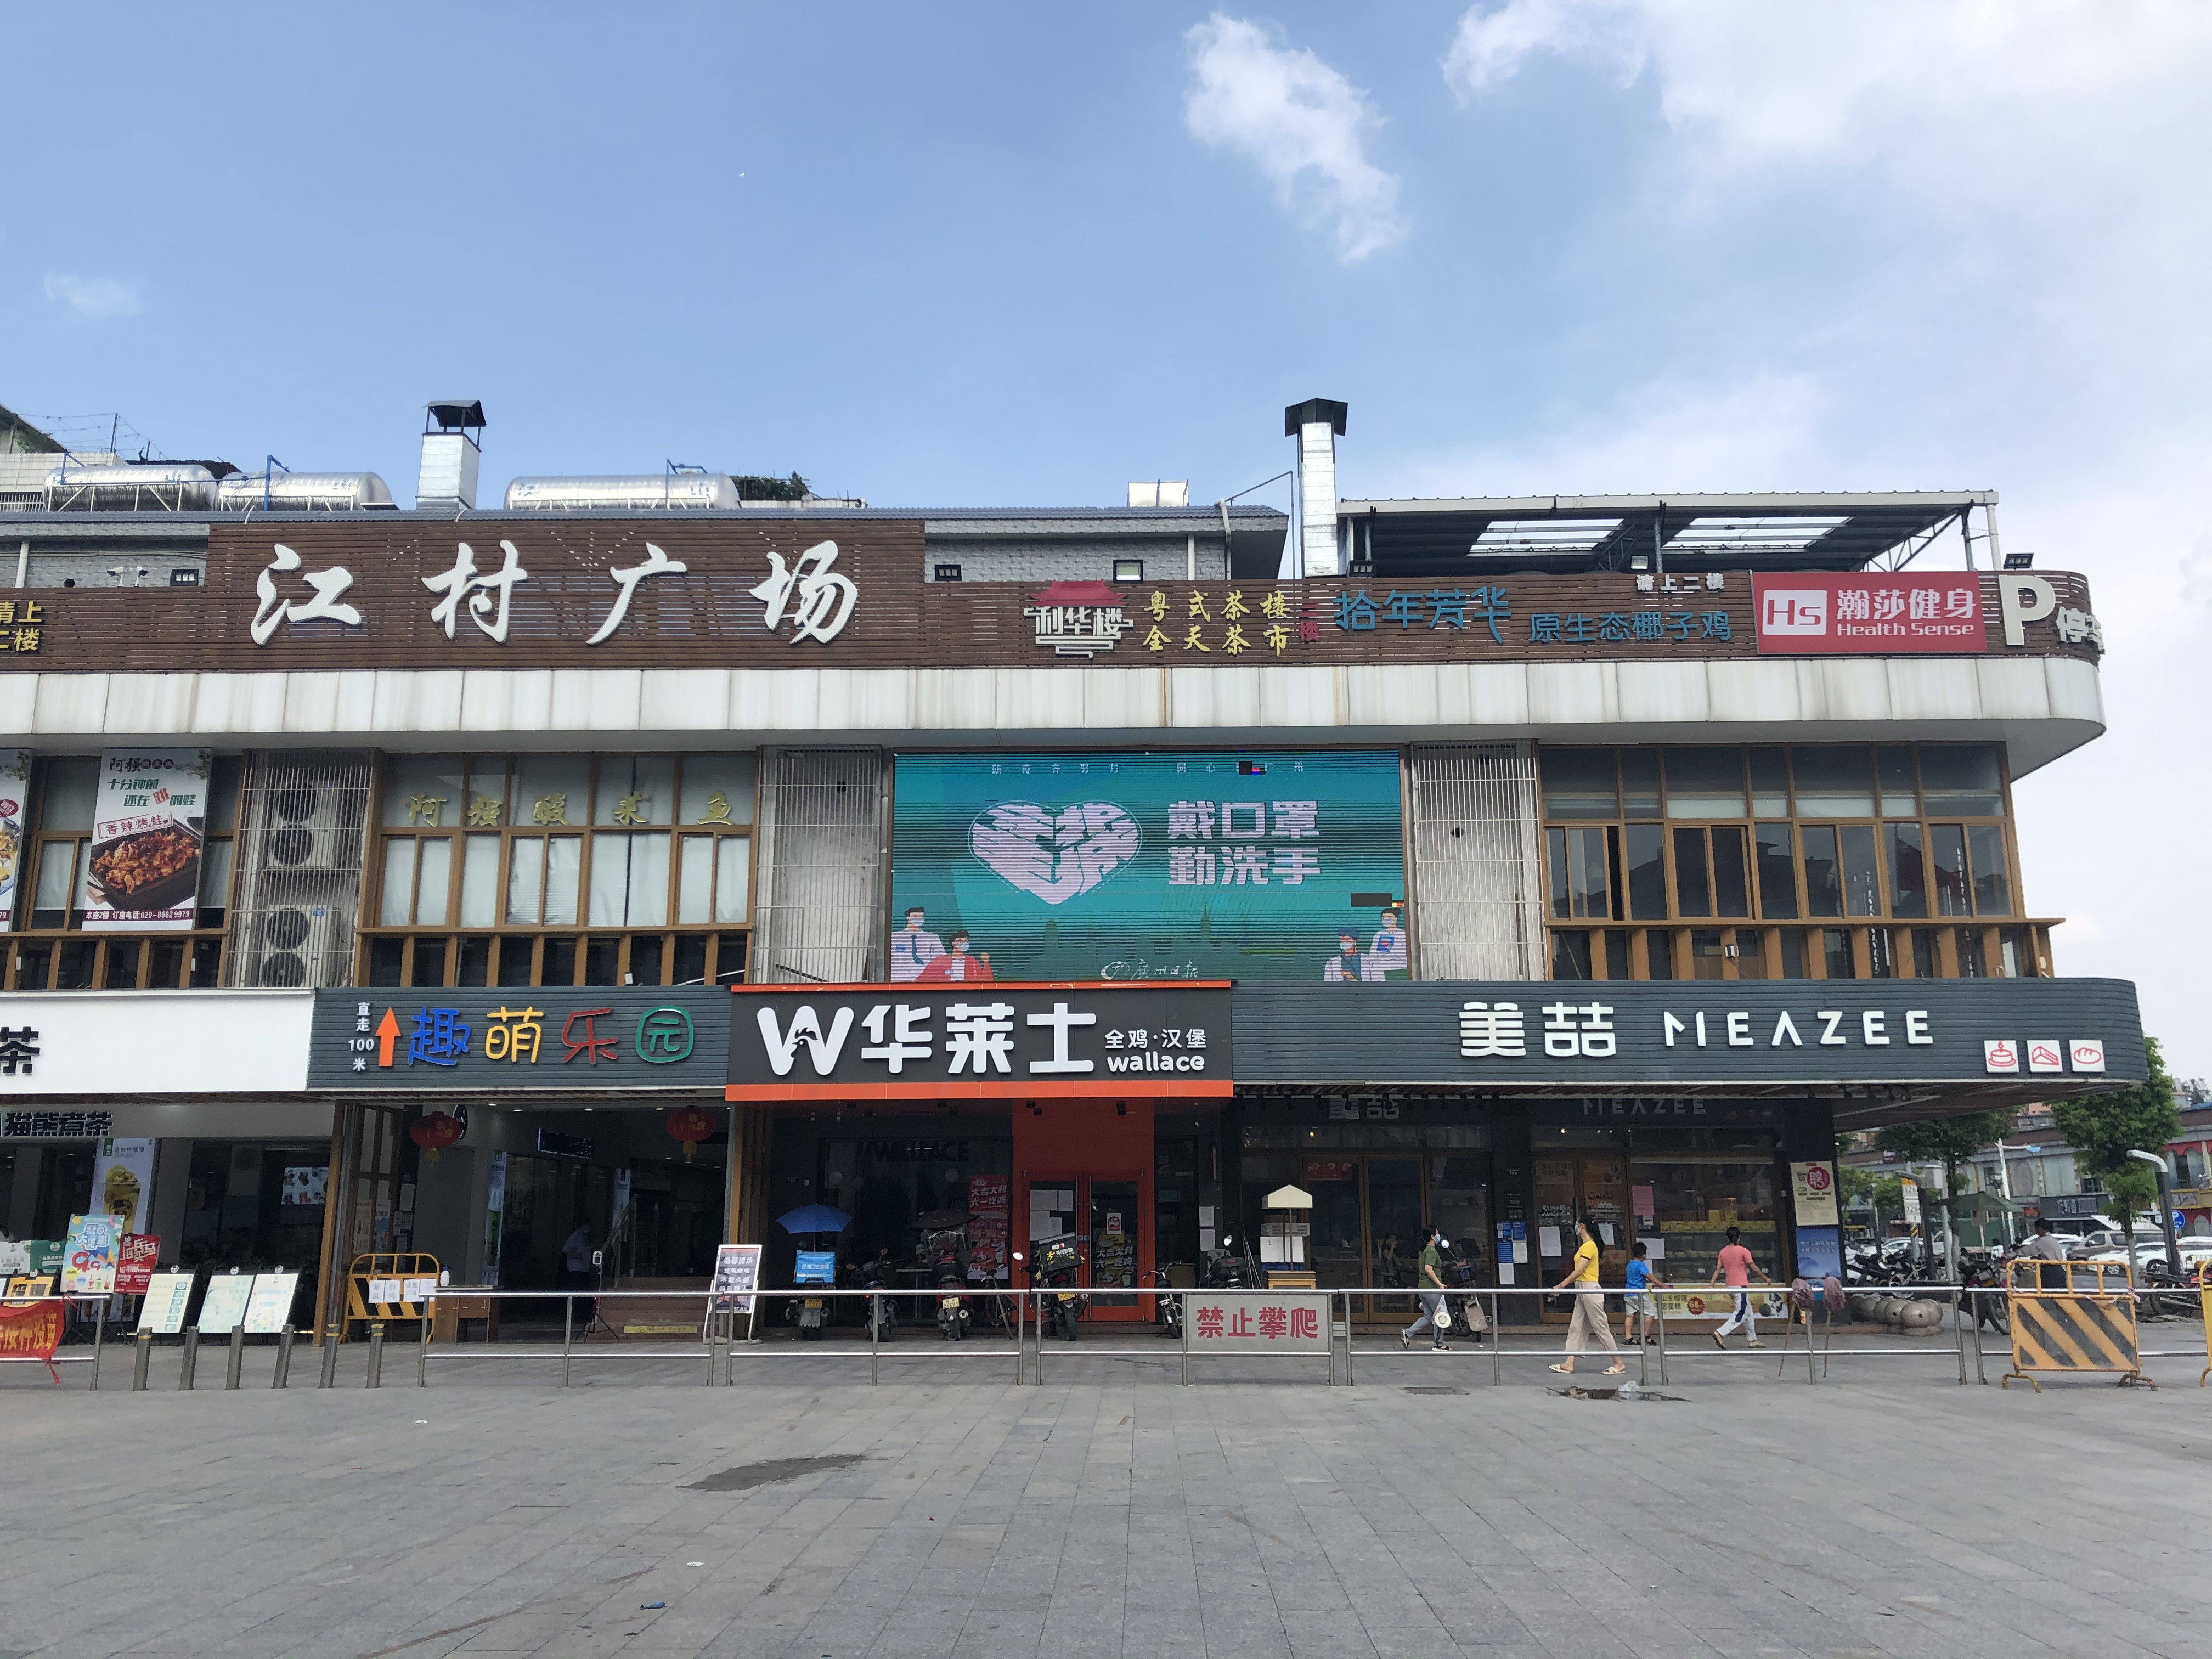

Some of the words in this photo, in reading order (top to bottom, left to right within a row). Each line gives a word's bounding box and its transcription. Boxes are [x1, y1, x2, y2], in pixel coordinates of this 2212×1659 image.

[250, 540, 859, 646] 江村广场
[1636, 573, 1724, 592] 请上二楼
[1144, 590, 1290, 622] 粤式茶楼
[1332, 586, 1512, 644] 拾年芳华
[1837, 588, 1978, 620] 瀚莎健身
[1998, 574, 2056, 646] P
[1024, 606, 1133, 647] 利华楼
[1143, 624, 1290, 657] 全天茶市
[1530, 611, 1732, 643] 原生态椰子鸡
[1837, 623, 1906, 636] Health
[1911, 622, 1974, 636] Sense
[108, 778, 159, 791] 十分钟前
[106, 814, 168, 835] 香辣烤蛙
[1168, 800, 1319, 840] 戴口罩
[1168, 846, 1322, 884] 勤洗手
[408, 1006, 694, 1066] 趣萌乐园
[861, 1003, 1096, 1074] 华莱士
[1459, 1002, 1617, 1058] 美喆
[0, 1026, 40, 1075] 茶
[1107, 1051, 1205, 1073] wallace
[970, 1195, 1006, 1207] 六一吃鸡
[971, 1184, 1007, 1197] 大吉大利
[1197, 1306, 1319, 1340] 禁止攀爬
